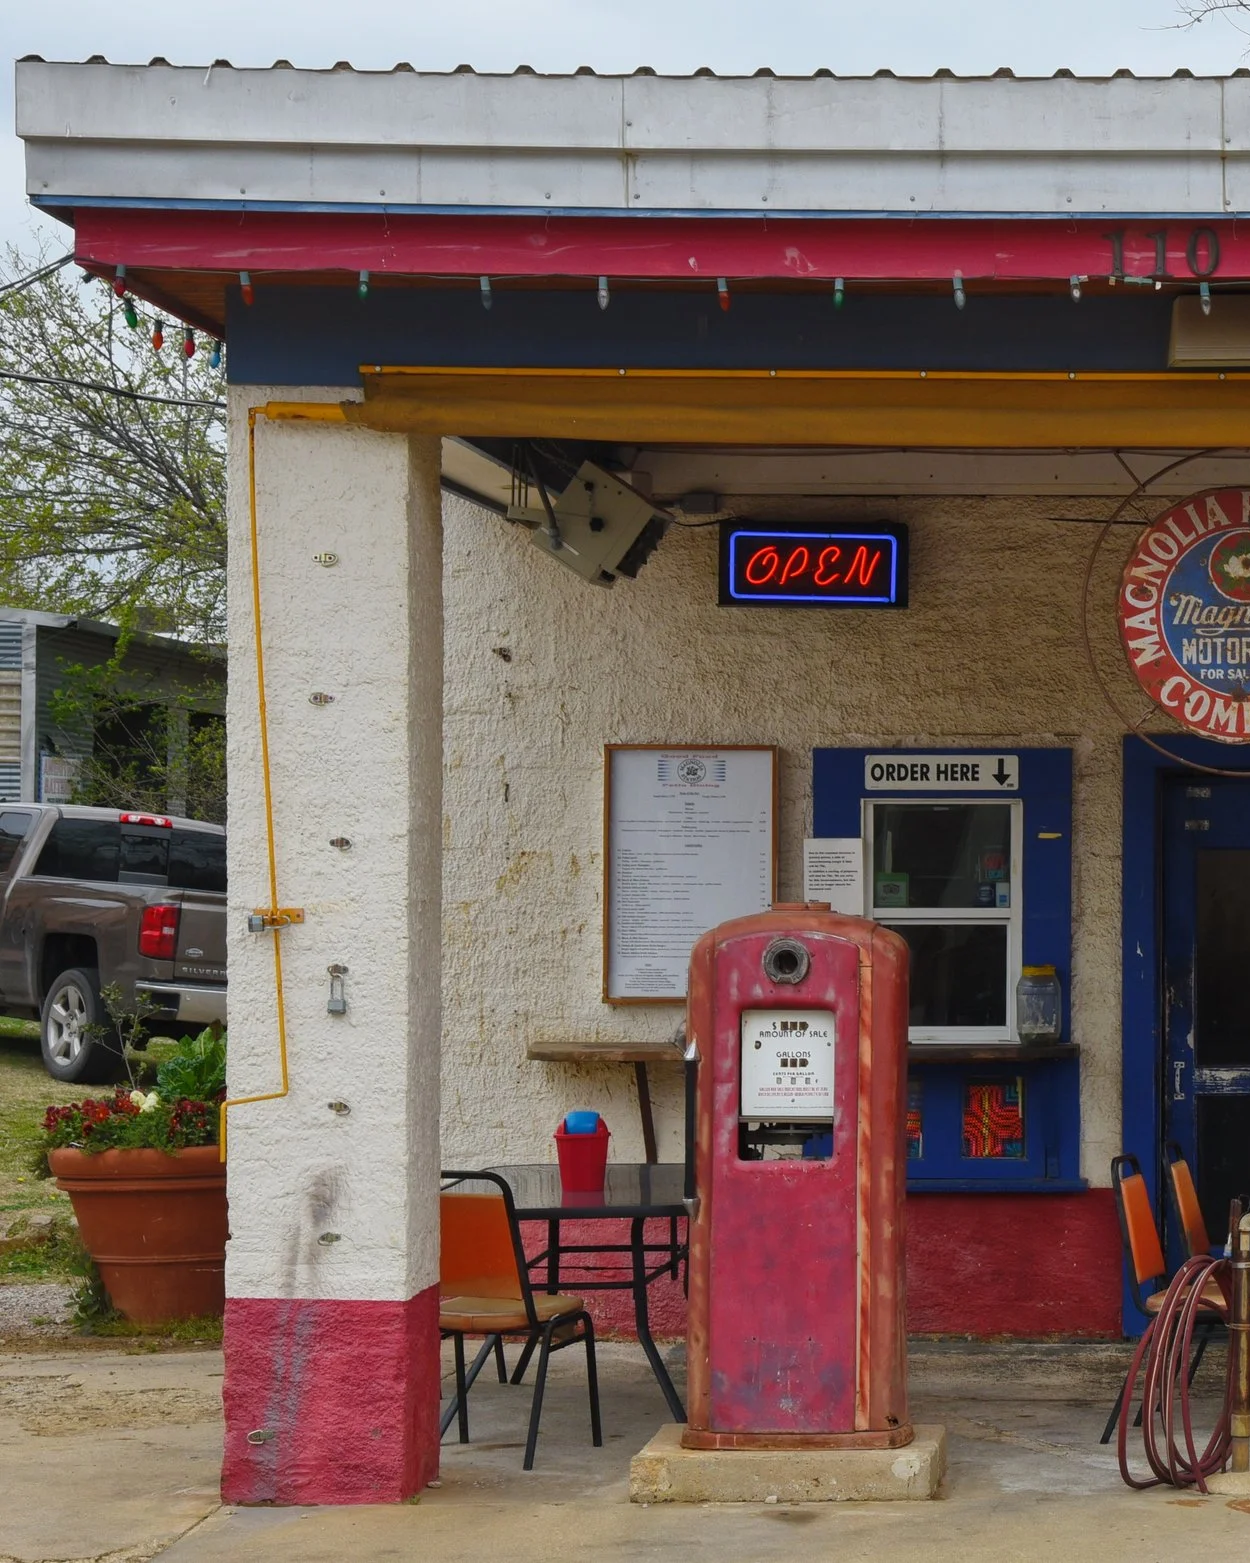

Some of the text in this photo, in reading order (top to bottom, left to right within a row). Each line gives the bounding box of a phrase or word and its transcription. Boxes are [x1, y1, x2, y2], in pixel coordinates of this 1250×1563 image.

[1102, 227, 1220, 277] 110
[745, 545, 881, 586] OPEN
[1124, 495, 1231, 668] MAGNOLIA
[1200, 669, 1224, 680] FOR
[871, 763, 980, 782] ORDER HERE
